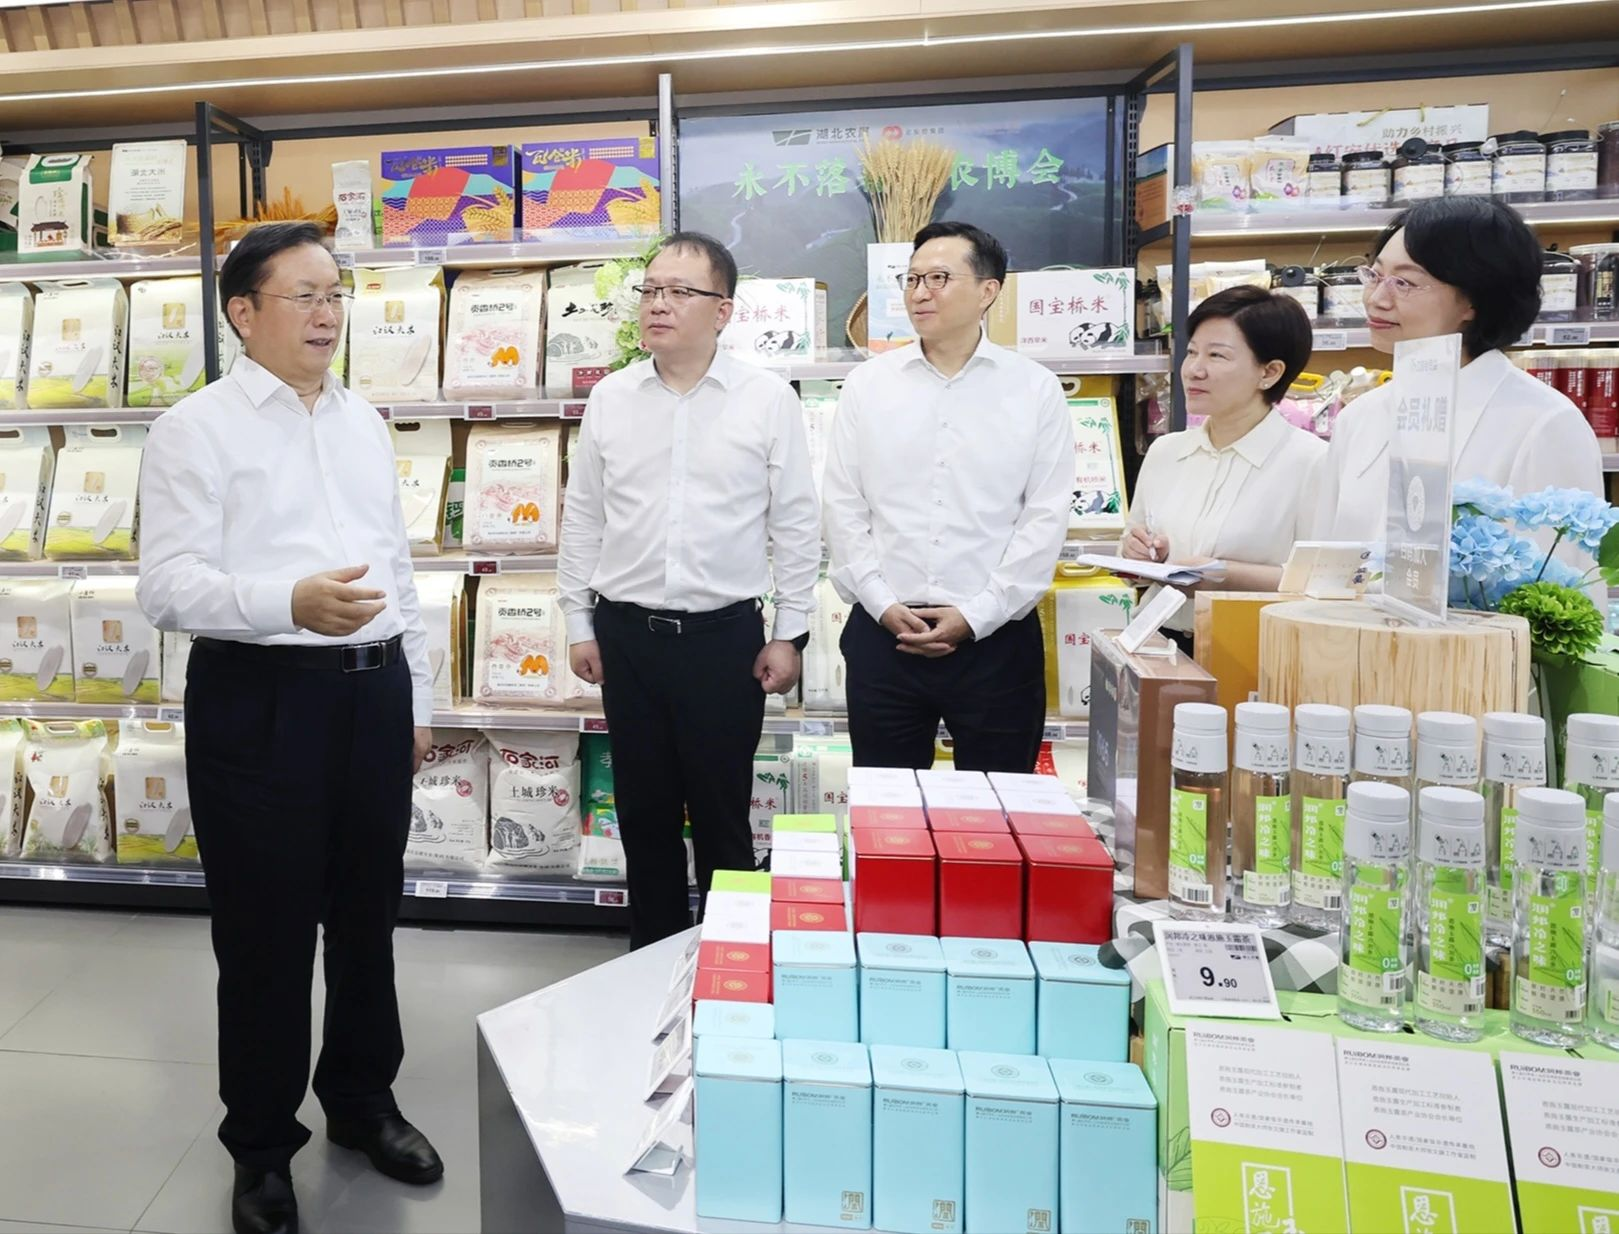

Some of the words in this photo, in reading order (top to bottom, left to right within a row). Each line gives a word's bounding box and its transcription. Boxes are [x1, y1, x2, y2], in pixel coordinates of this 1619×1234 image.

[1382, 124, 1463, 139] 助力乡村振兴
[732, 147, 1065, 201] 永不落农博会
[734, 303, 791, 323] 宝桥米
[1029, 295, 1109, 315] 国宝桥米
[1065, 632, 1090, 646] 国宝
[499, 748, 560, 770] 石家河
[824, 792, 848, 805] 国宝
[1200, 966, 1238, 989] 9.90
[1249, 1170, 1281, 1234] 恩施
[1410, 1195, 1438, 1234] 恩
